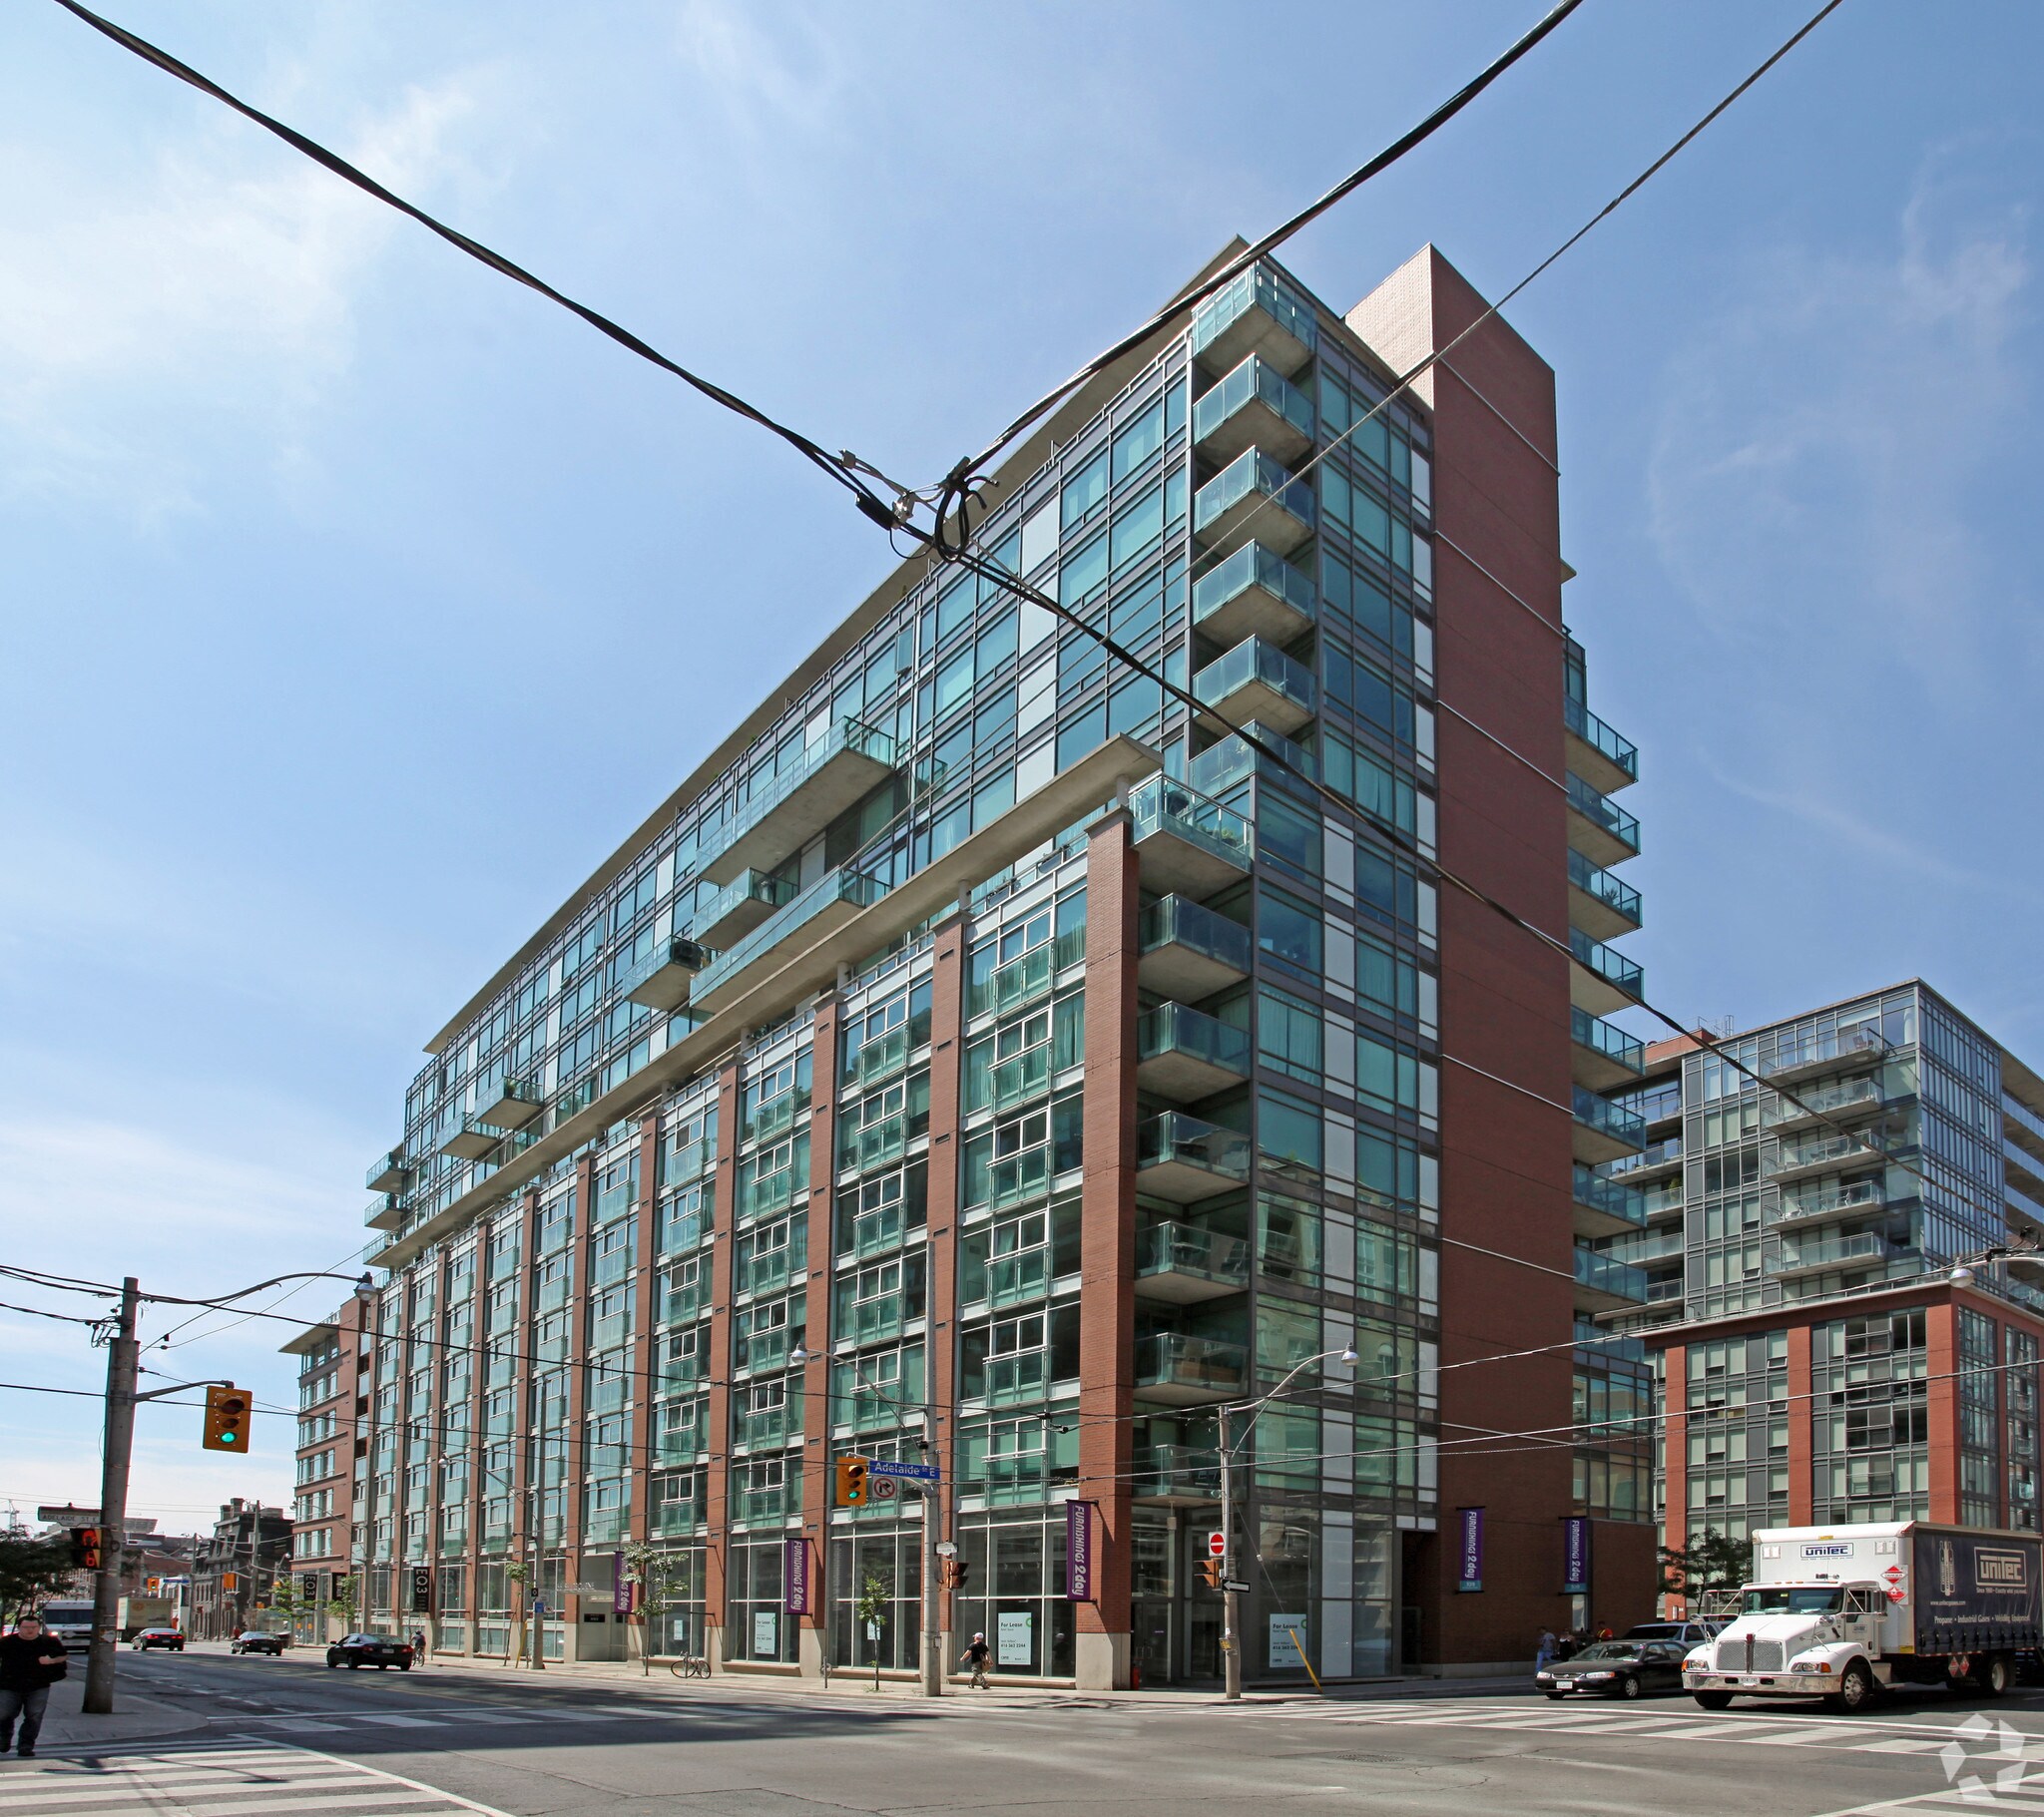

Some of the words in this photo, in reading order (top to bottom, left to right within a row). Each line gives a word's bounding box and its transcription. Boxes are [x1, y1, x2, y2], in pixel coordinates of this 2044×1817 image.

[874, 1462, 920, 1476] Adelaide
[929, 1467, 936, 1477] E
[1075, 1505, 1085, 1564] FURNISHINGS
[1468, 1511, 1477, 1554] FURNISHINGS
[1571, 1520, 1580, 1560] FURNISHINGS
[793, 1540, 802, 1586] FURNISHINGS
[1072, 1564, 1086, 1595] 2day
[415, 1569, 428, 1593] EQ3
[1934, 1615, 1953, 1625] Propane
[1957, 1613, 1977, 1623] Industrial
